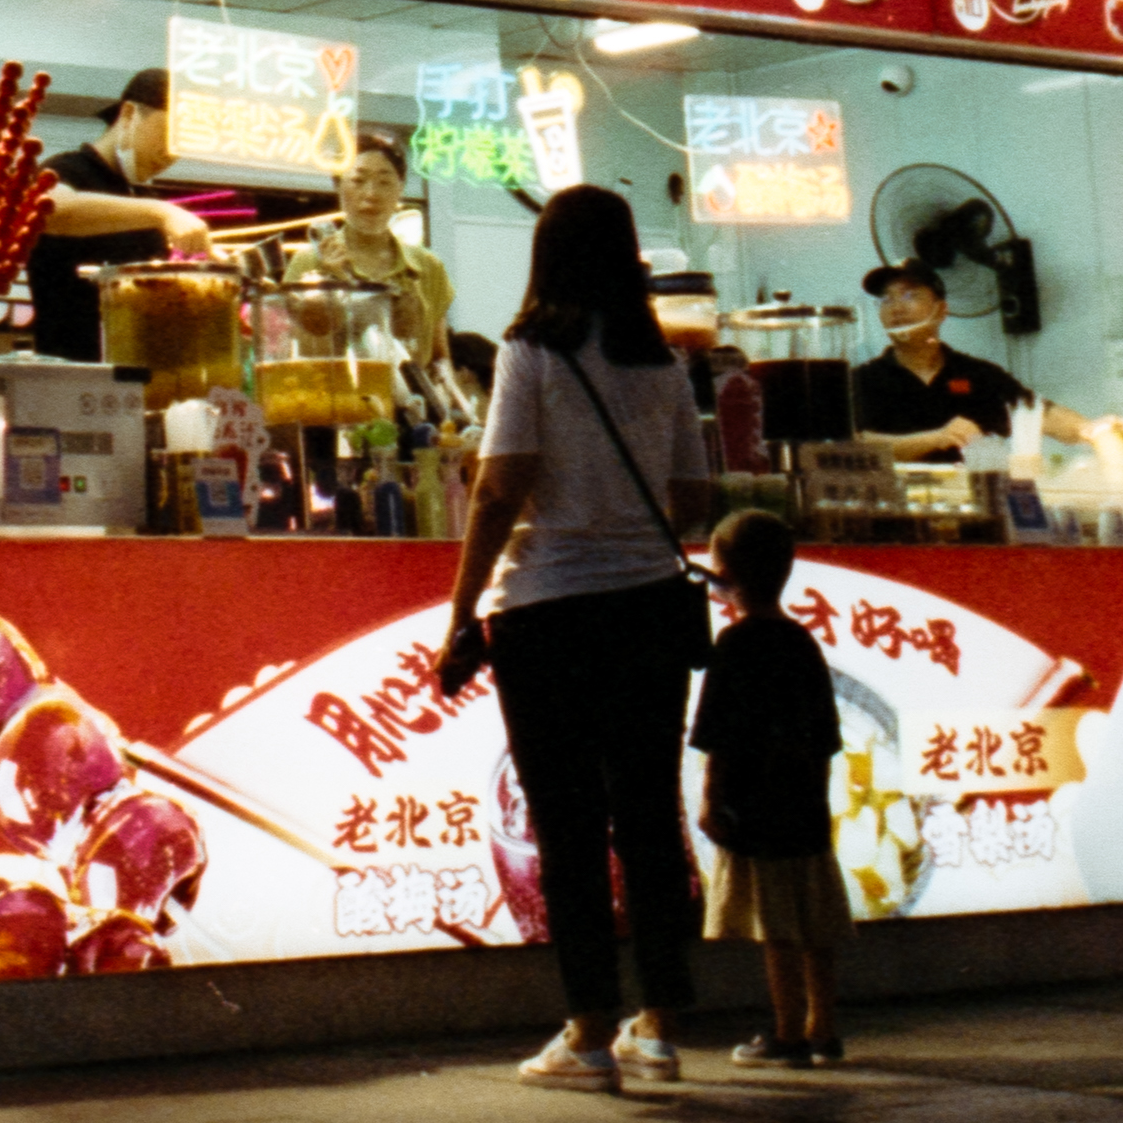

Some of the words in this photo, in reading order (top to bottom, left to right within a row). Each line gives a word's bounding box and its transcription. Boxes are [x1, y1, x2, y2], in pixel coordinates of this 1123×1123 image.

[174, 26, 319, 99] 老北京
[692, 100, 812, 157] 老北京
[920, 722, 1049, 781] 老北京
[332, 790, 481, 854] 老北京
